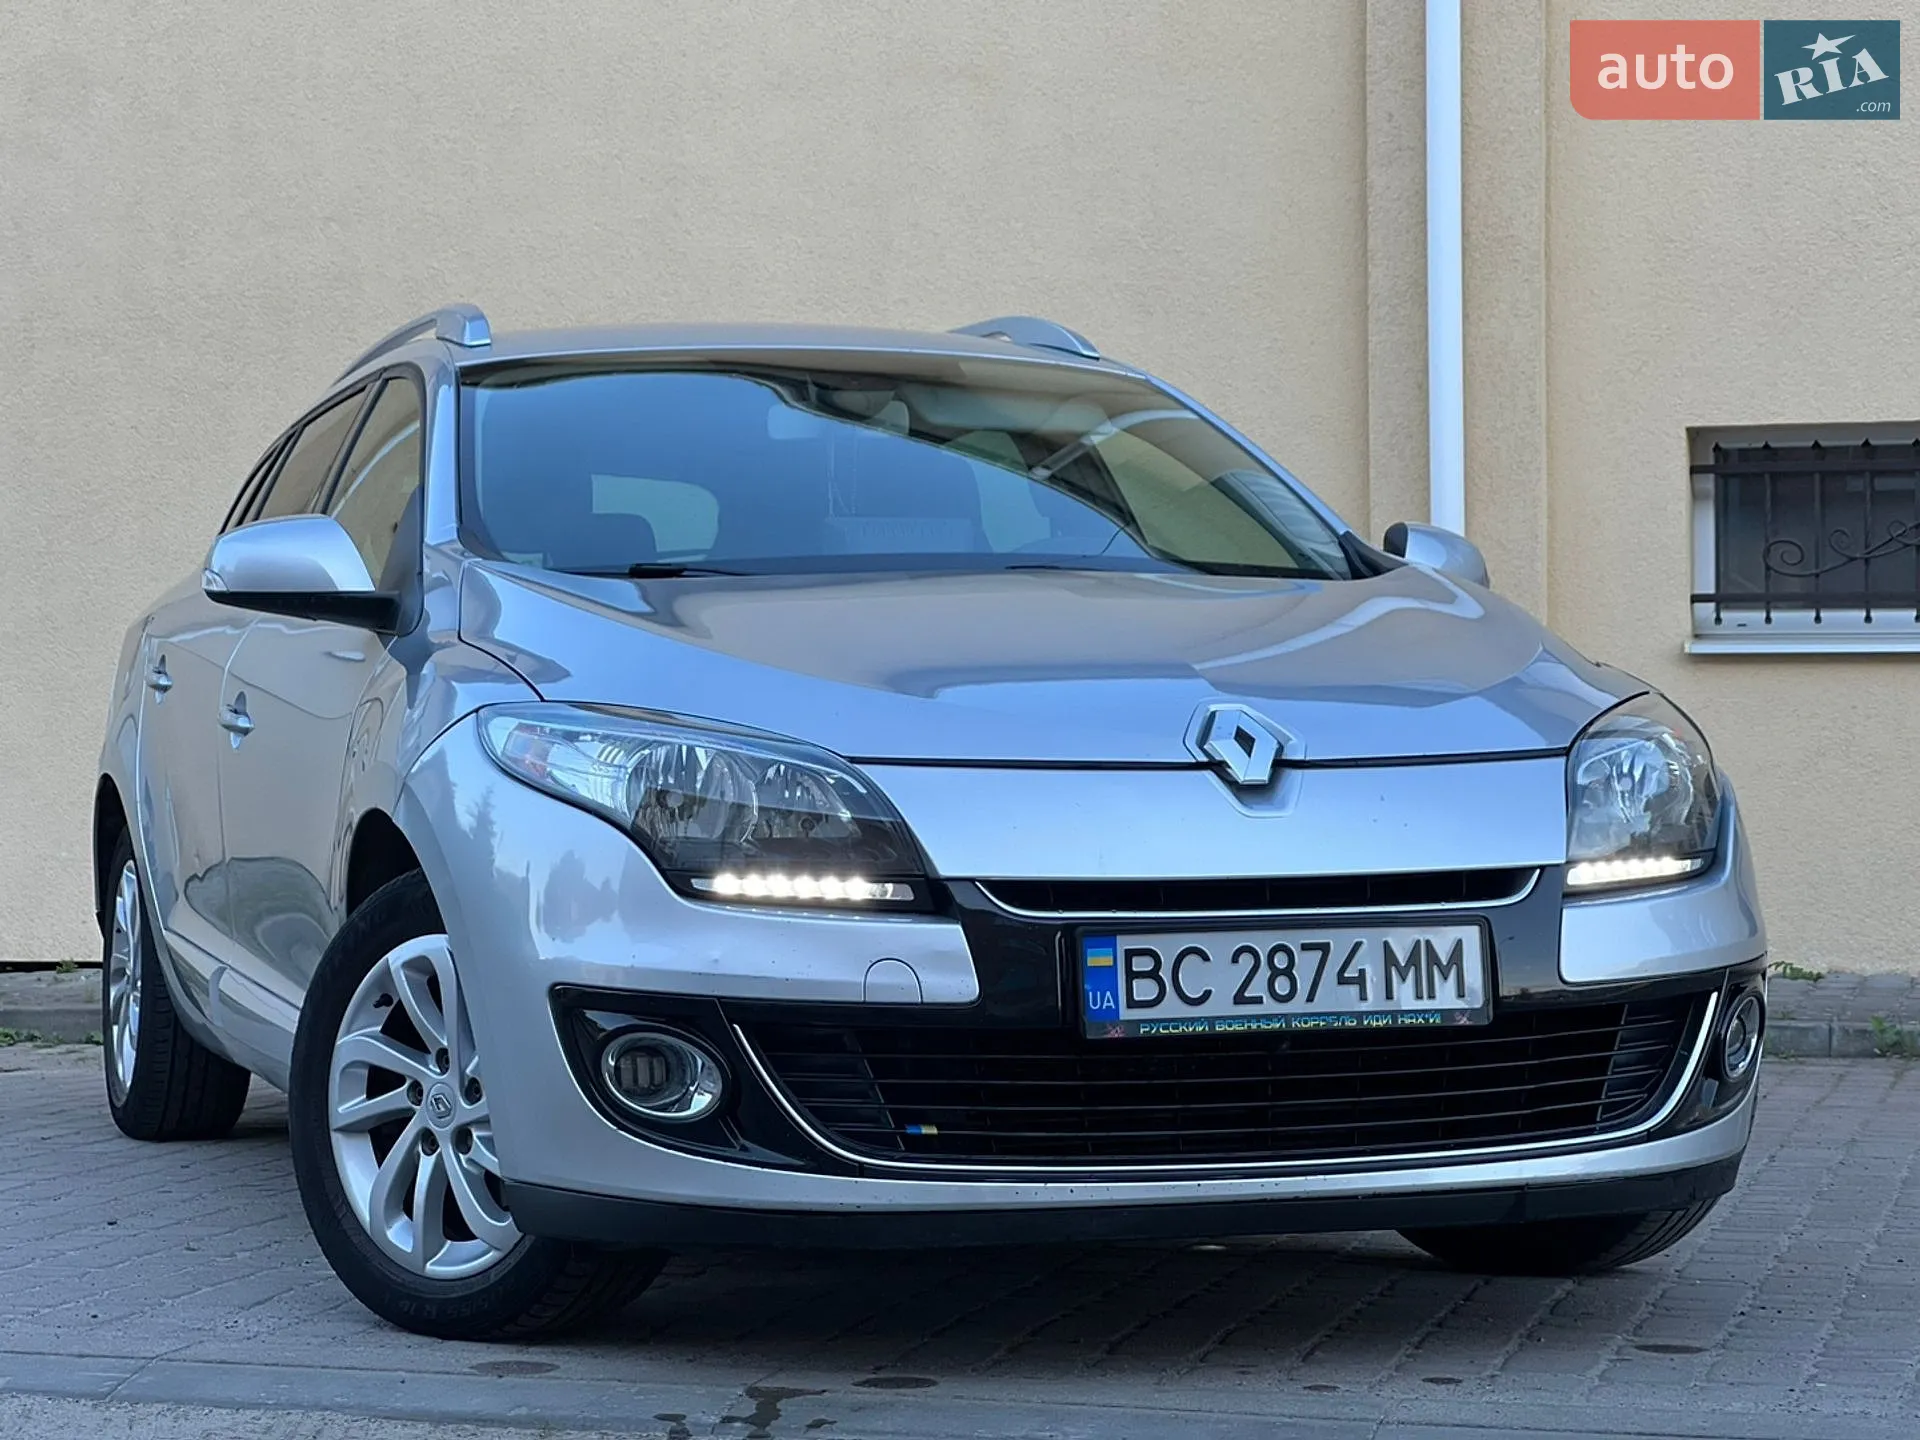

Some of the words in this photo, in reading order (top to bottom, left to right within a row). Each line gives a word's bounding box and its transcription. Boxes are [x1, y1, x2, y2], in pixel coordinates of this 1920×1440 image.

[1124, 945, 1213, 1009] BC
[1231, 940, 1369, 1006] 2874
[1383, 938, 1465, 1000] MM
[1089, 991, 1115, 1010] UA
[1140, 1017, 1209, 1034] РУССКИЙ
[1215, 1015, 1286, 1031] ВОЕННЫЙ
[1362, 1013, 1392, 1028] ИДИ
